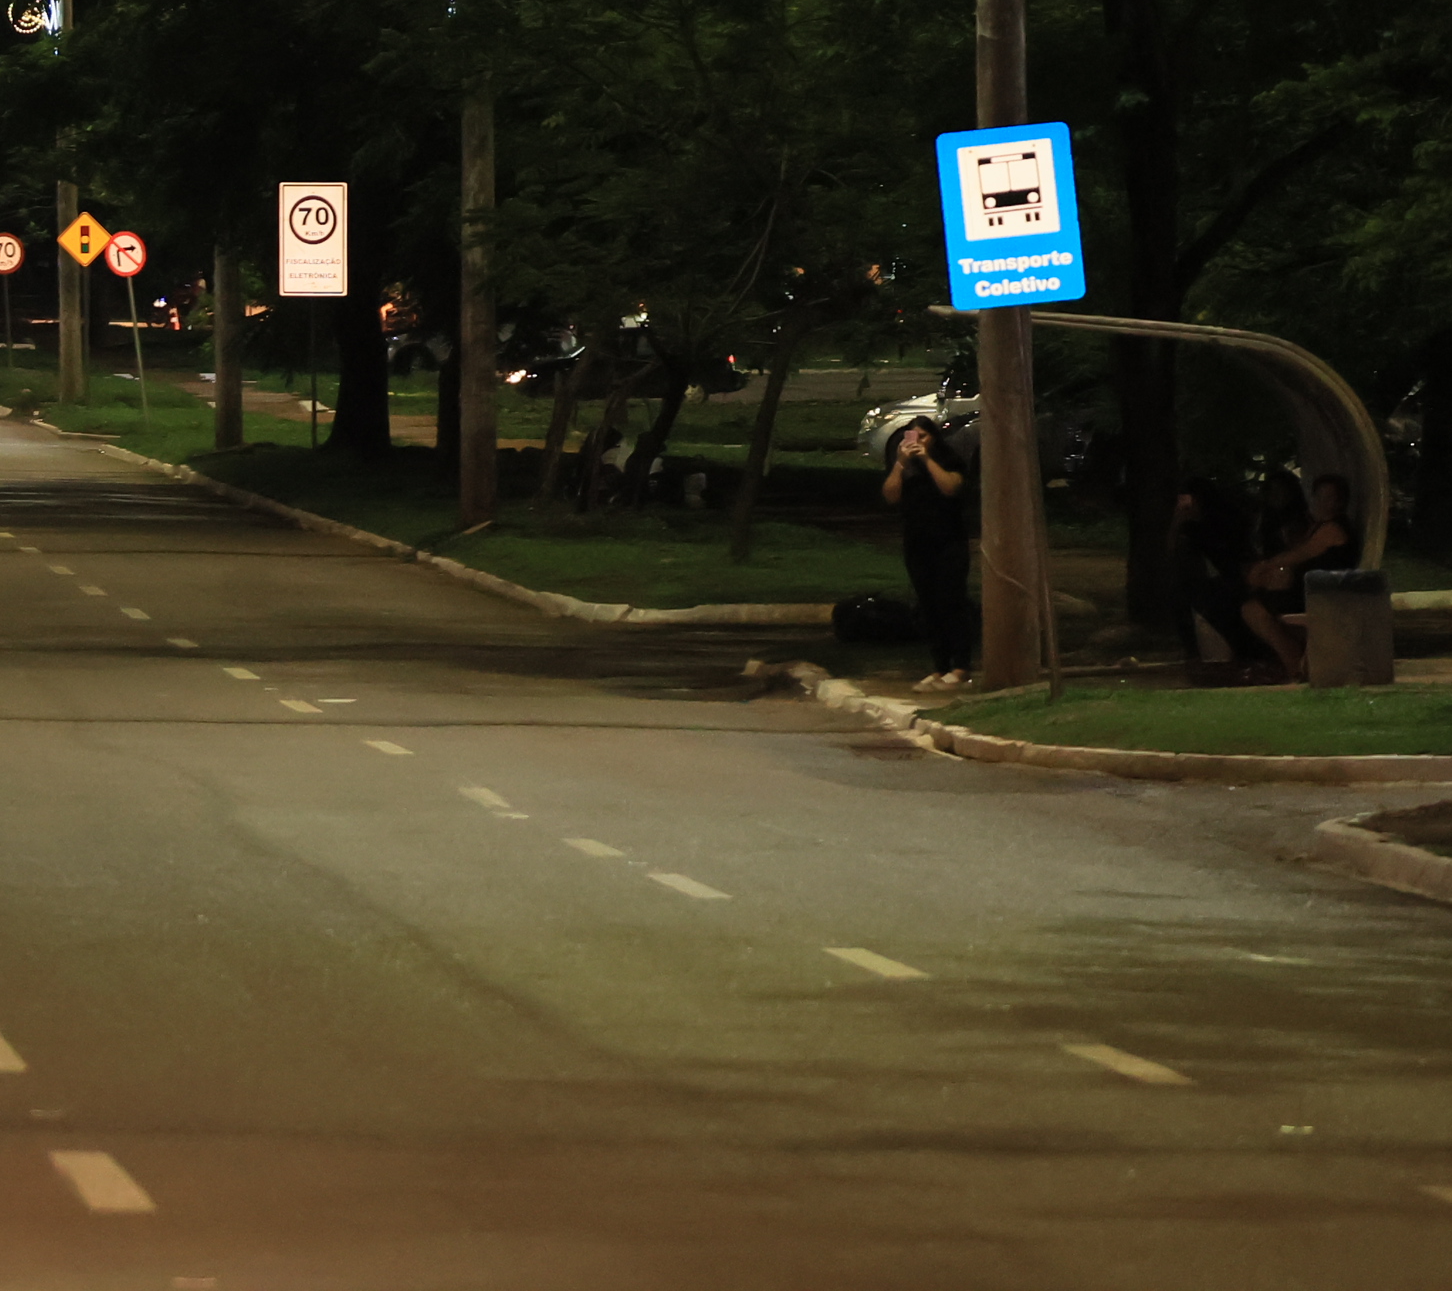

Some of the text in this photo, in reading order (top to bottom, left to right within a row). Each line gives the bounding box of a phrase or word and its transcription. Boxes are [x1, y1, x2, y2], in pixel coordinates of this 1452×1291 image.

[298, 207, 330, 226] 70
[286, 257, 342, 266] FISCALIZAÇÃO
[957, 250, 1074, 275] Transporte
[974, 276, 1061, 297] Coletivo
